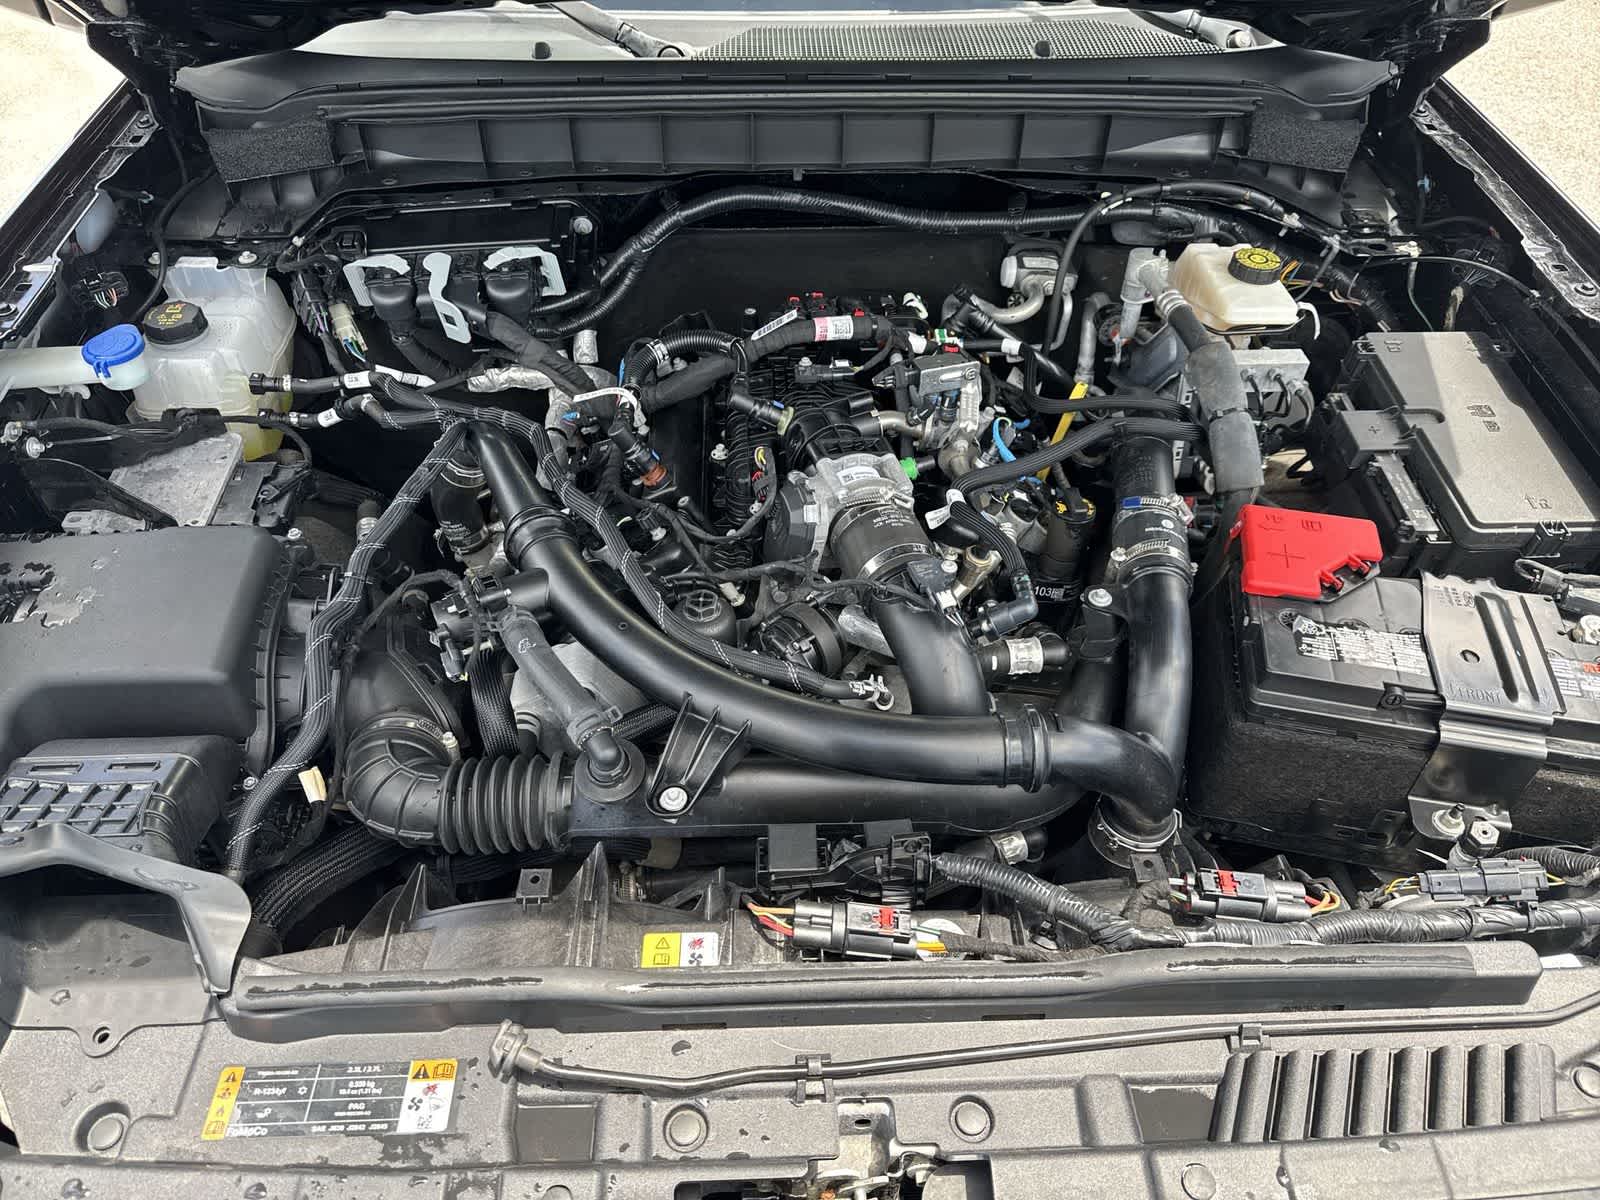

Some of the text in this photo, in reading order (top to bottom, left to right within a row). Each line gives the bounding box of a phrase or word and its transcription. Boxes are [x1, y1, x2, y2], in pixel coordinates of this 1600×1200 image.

[253, 1086, 287, 1097] R-1234yf
[348, 1102, 365, 1110] PAG
[226, 1127, 268, 1137] FoMoCo
